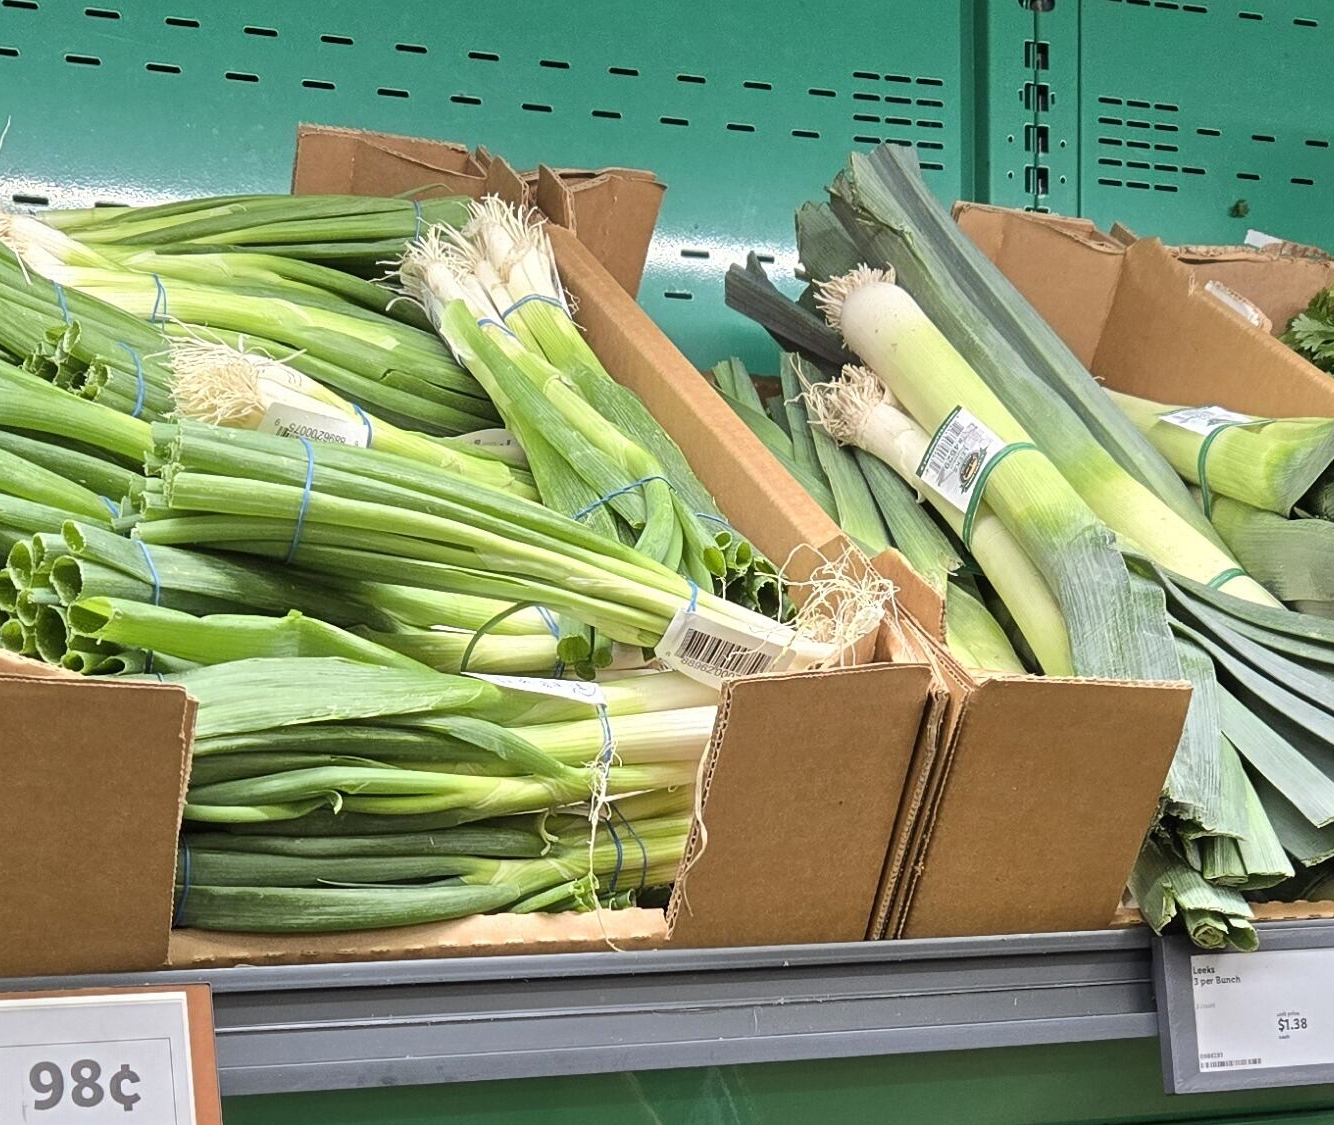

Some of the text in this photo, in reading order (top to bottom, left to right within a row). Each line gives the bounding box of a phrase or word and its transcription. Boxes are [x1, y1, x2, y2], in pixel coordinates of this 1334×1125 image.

[1193, 966, 1216, 975] Leeks
[1194, 976, 1241, 987] 3 per Bunch
[1278, 1017, 1308, 1032] $1.38
[28, 1058, 142, 1113] 98¢
